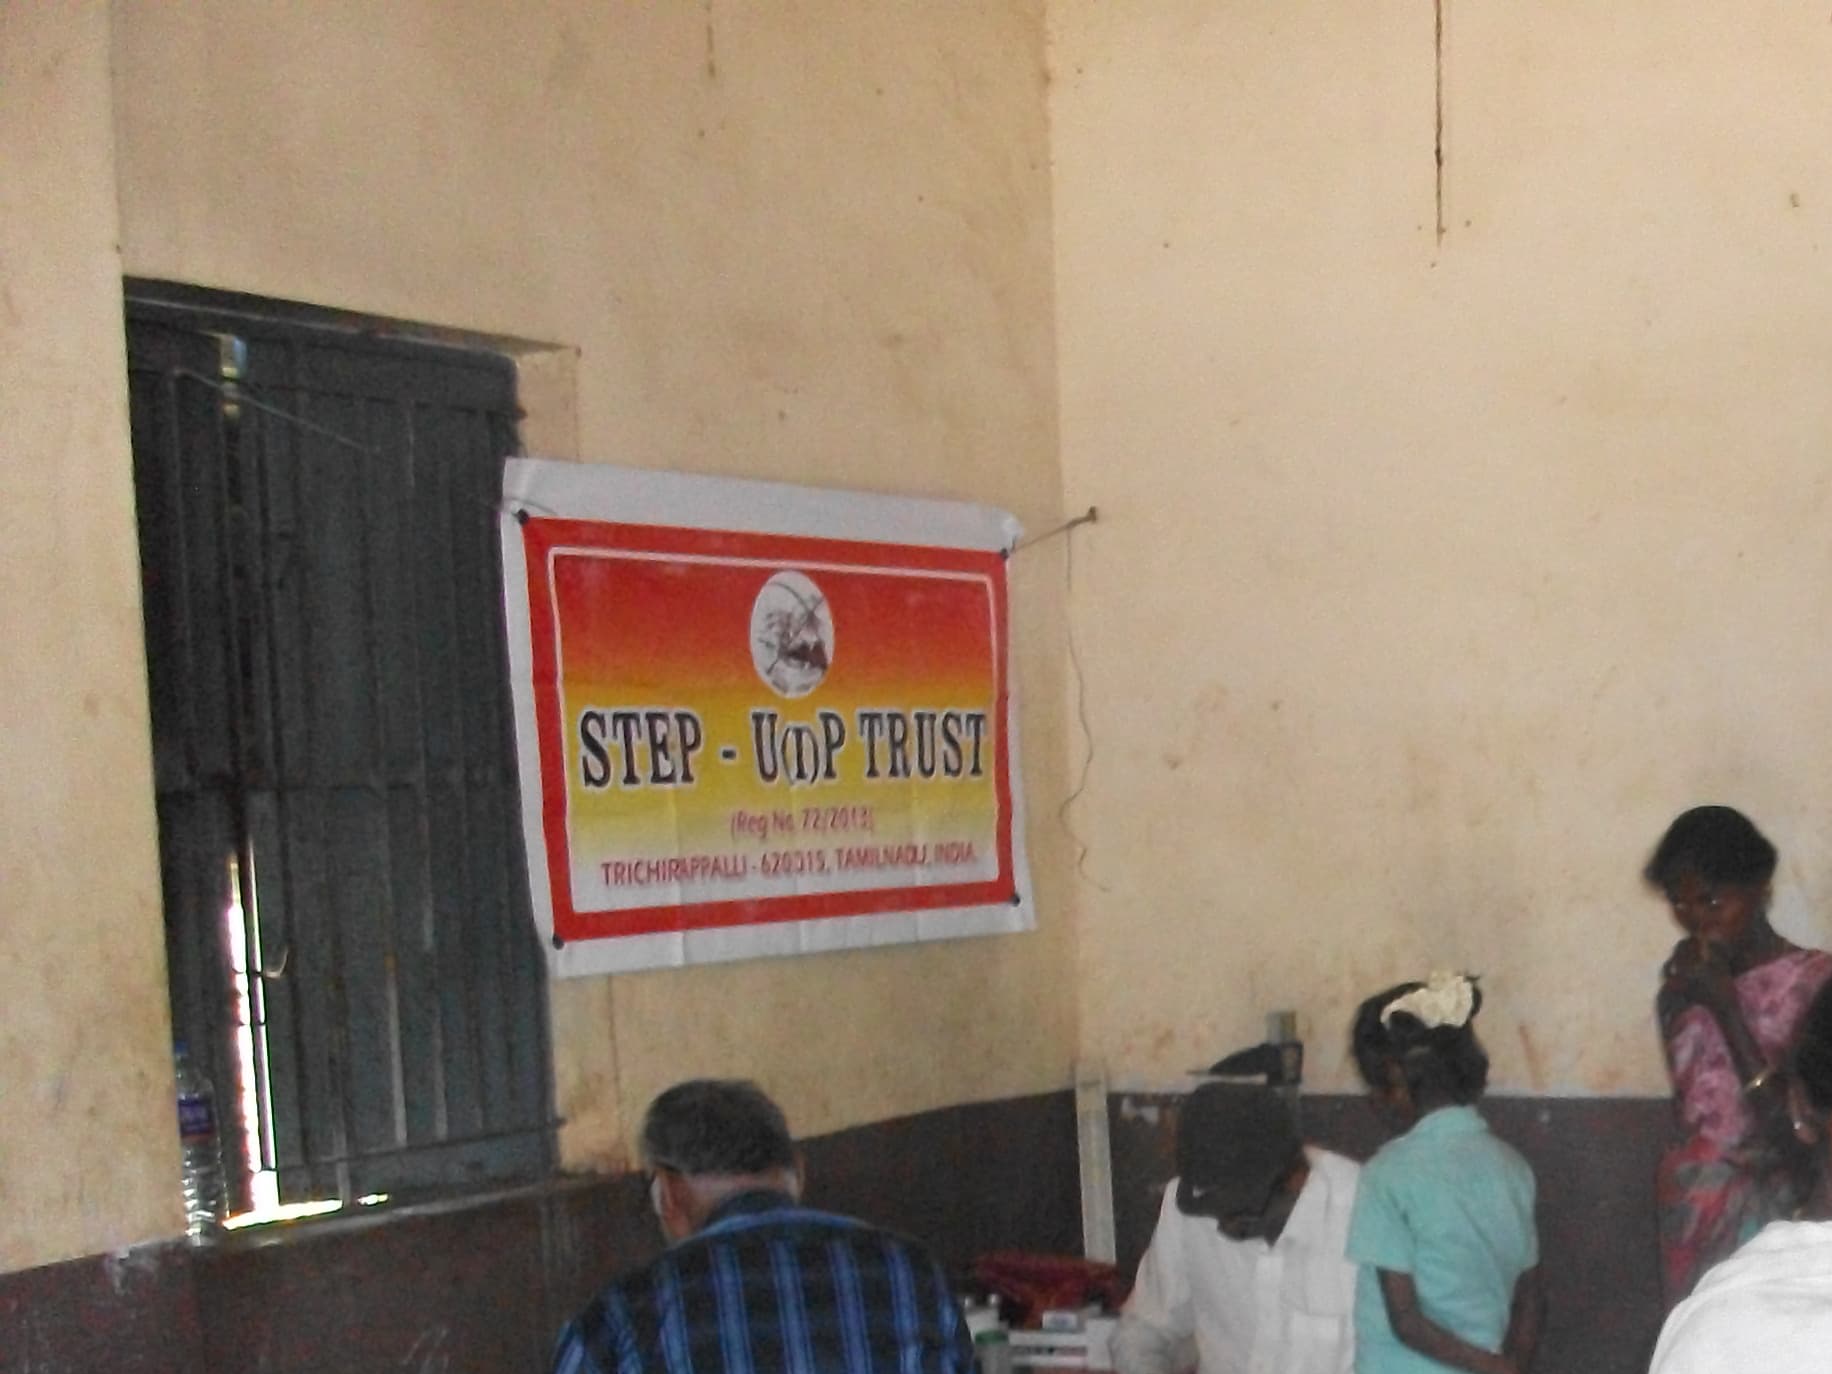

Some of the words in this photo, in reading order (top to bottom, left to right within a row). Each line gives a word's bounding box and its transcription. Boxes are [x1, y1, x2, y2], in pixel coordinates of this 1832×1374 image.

[580, 710, 703, 788] STEP
[722, 748, 737, 760] -
[858, 711, 986, 779] TRUST
